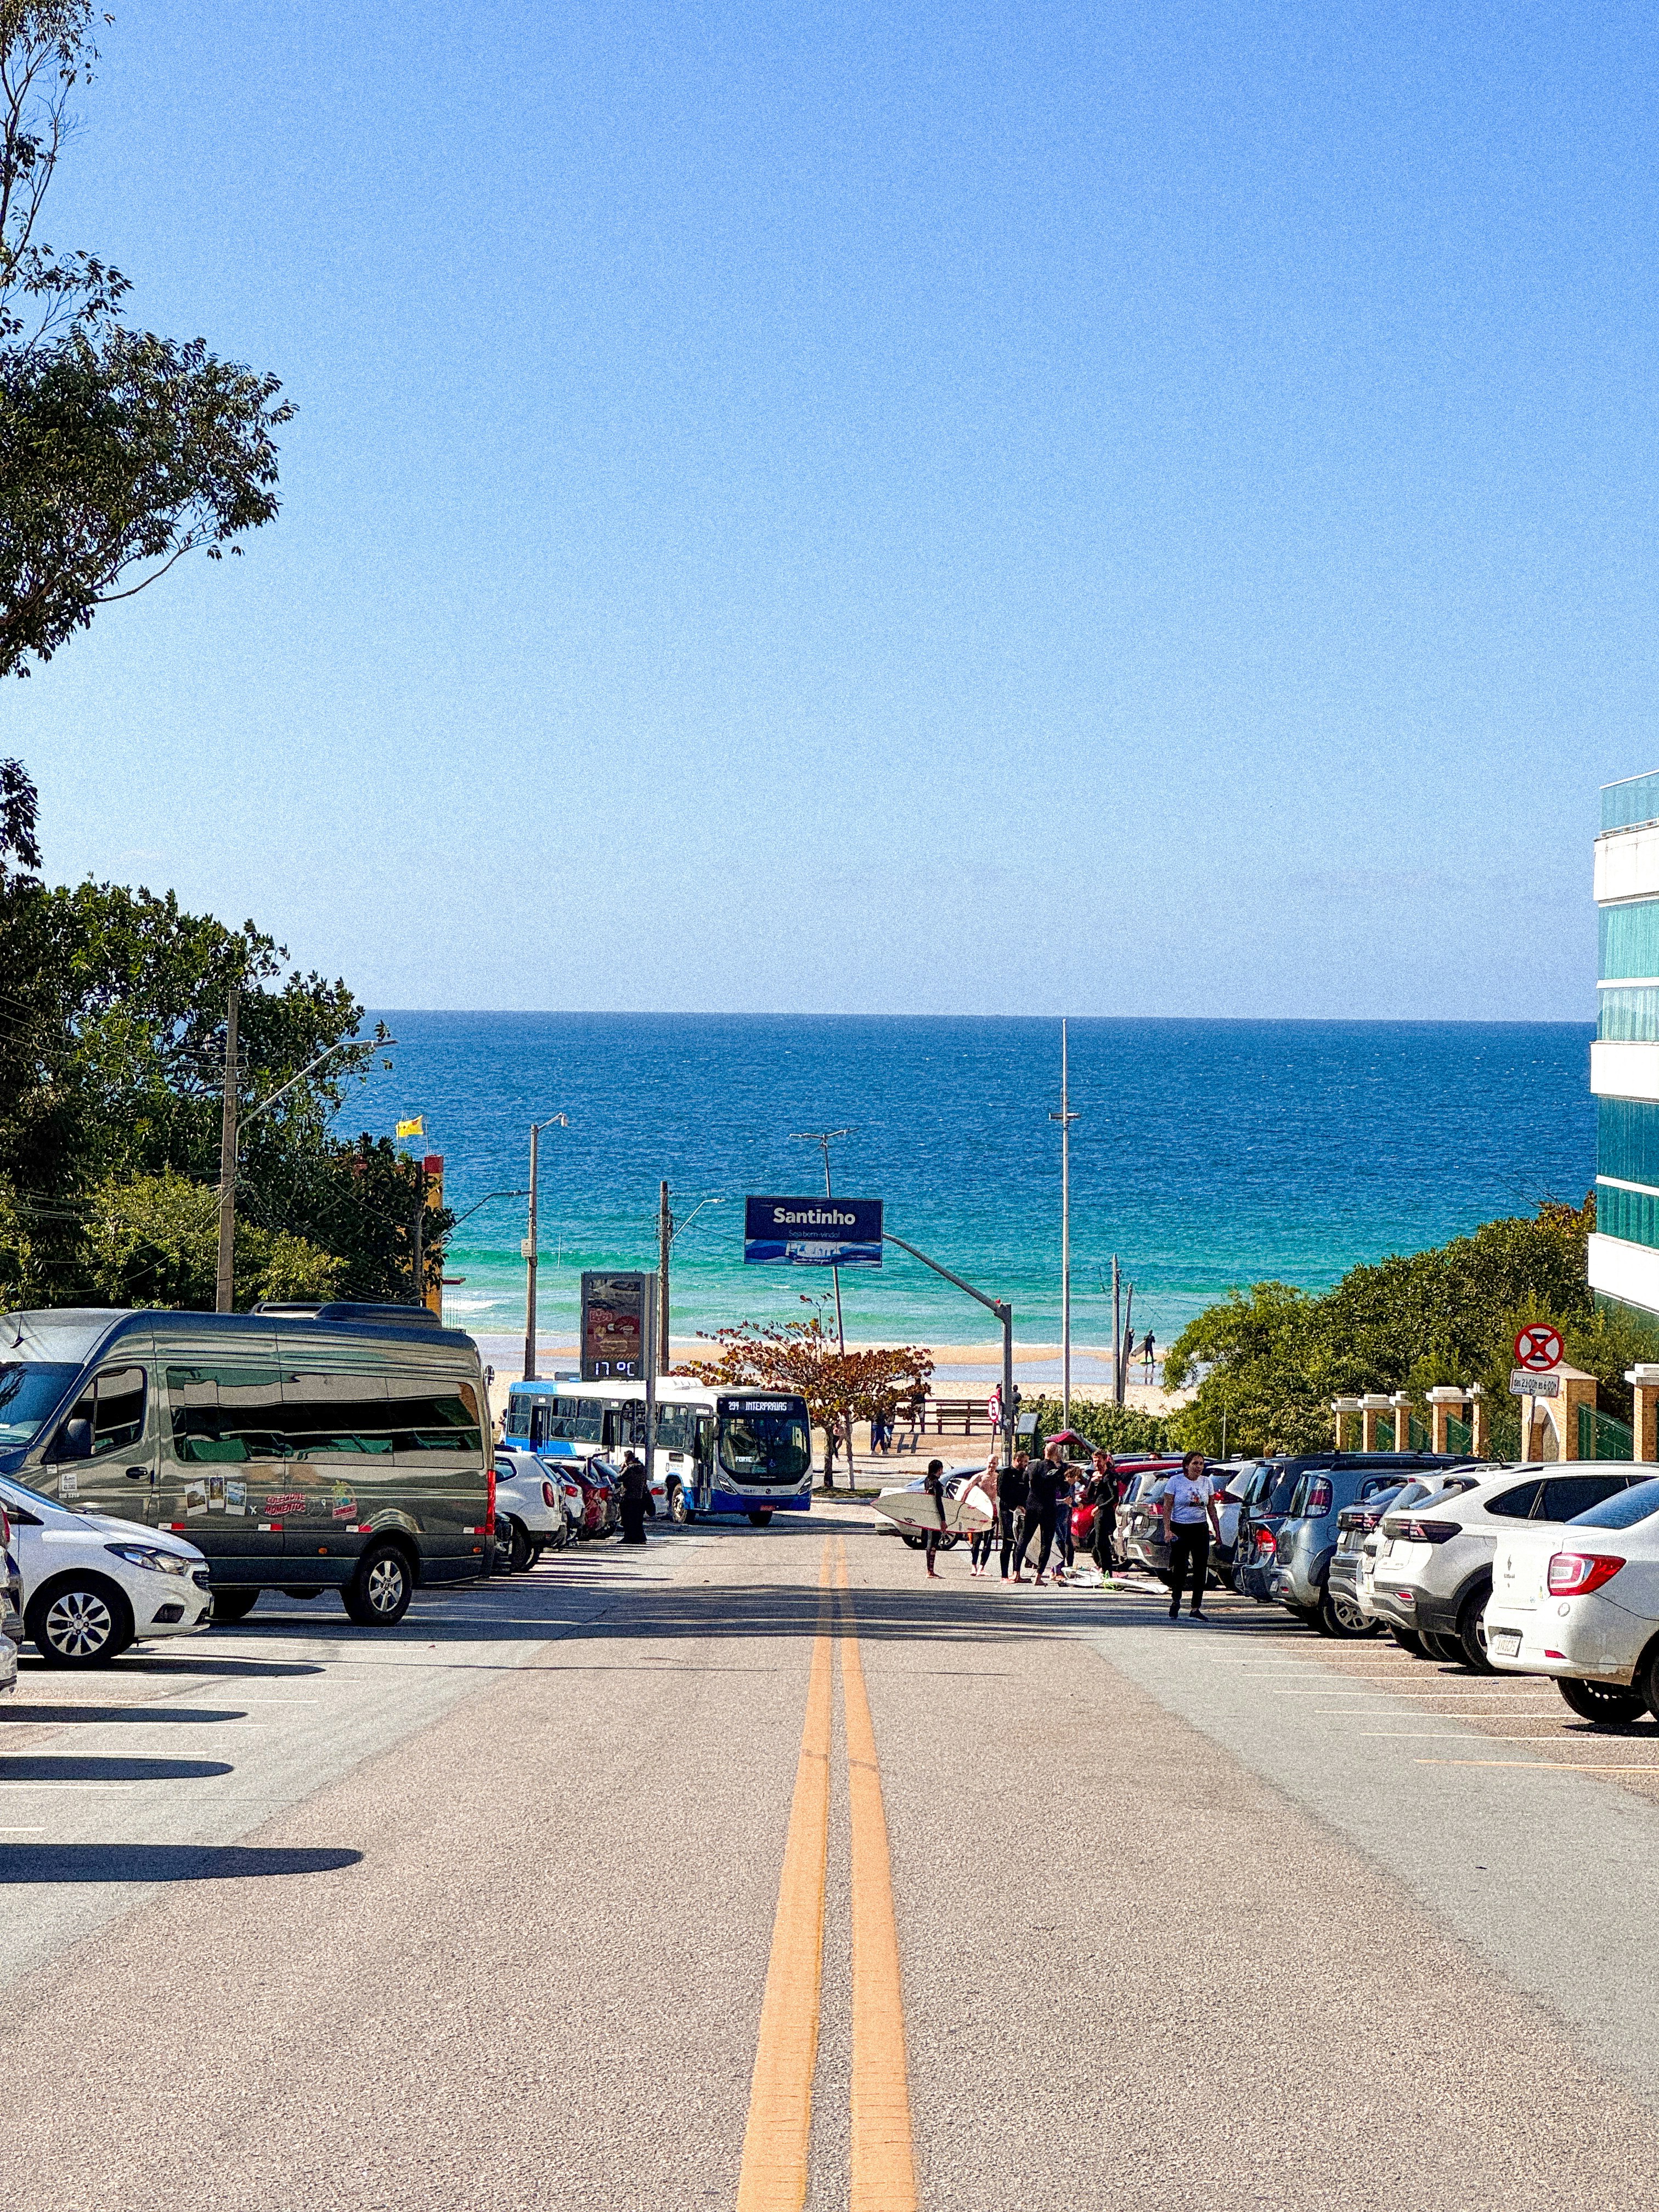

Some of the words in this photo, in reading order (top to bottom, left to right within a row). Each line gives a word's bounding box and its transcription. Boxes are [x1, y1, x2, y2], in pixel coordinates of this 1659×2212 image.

[773, 1207, 856, 1225] Santinho
[595, 1362, 610, 1375] 17
[729, 1401, 740, 1410] 294
[746, 1401, 787, 1411] INTERPRAIAS
[264, 1502, 306, 1516] MOMENTOS
